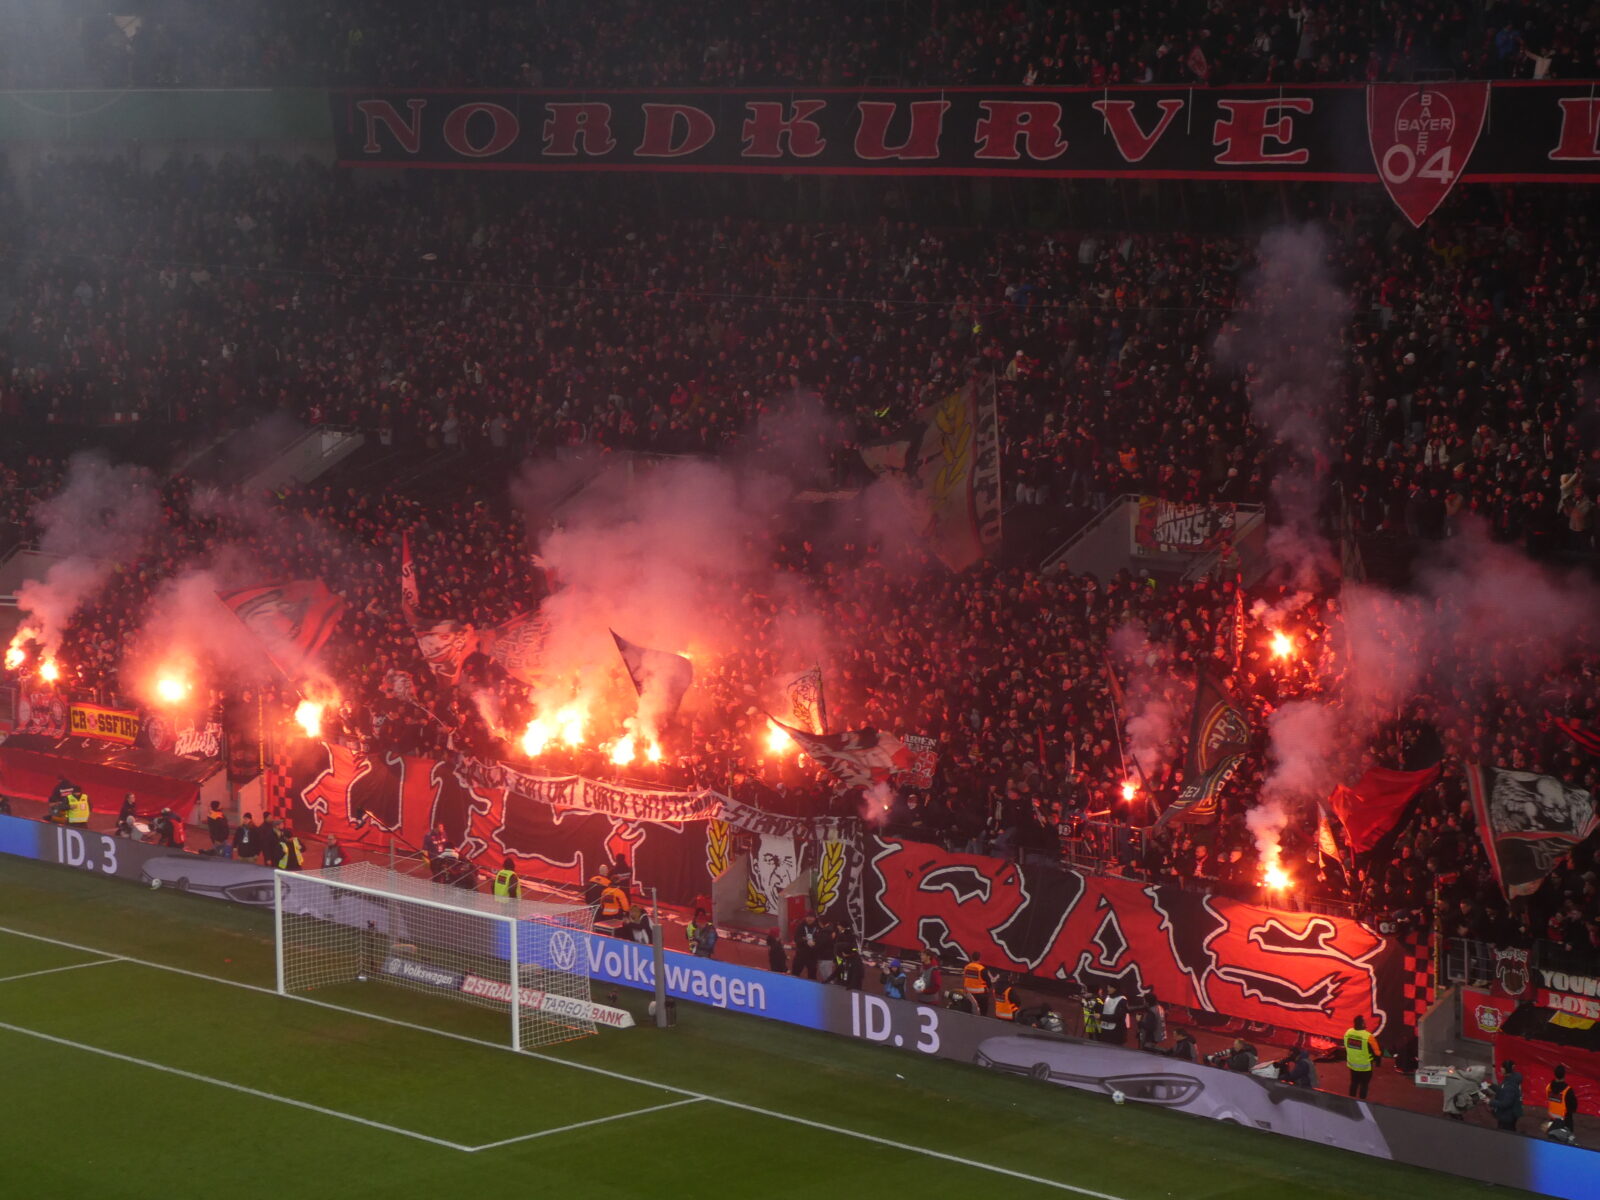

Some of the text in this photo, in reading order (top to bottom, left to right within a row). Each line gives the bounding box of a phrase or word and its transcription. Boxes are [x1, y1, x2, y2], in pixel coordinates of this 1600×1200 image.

[356, 97, 1314, 164] NORDKURVE
[1398, 118, 1452, 131] BAYER
[1416, 94, 1432, 155] BAYER
[1382, 144, 1454, 184] 04
[72, 709, 138, 738] CROSSFIRE
[57, 827, 118, 874] ID. 3
[403, 963, 453, 984] Volkswagen
[585, 937, 766, 1010] Volkwagen
[852, 992, 940, 1053] ID. 3
